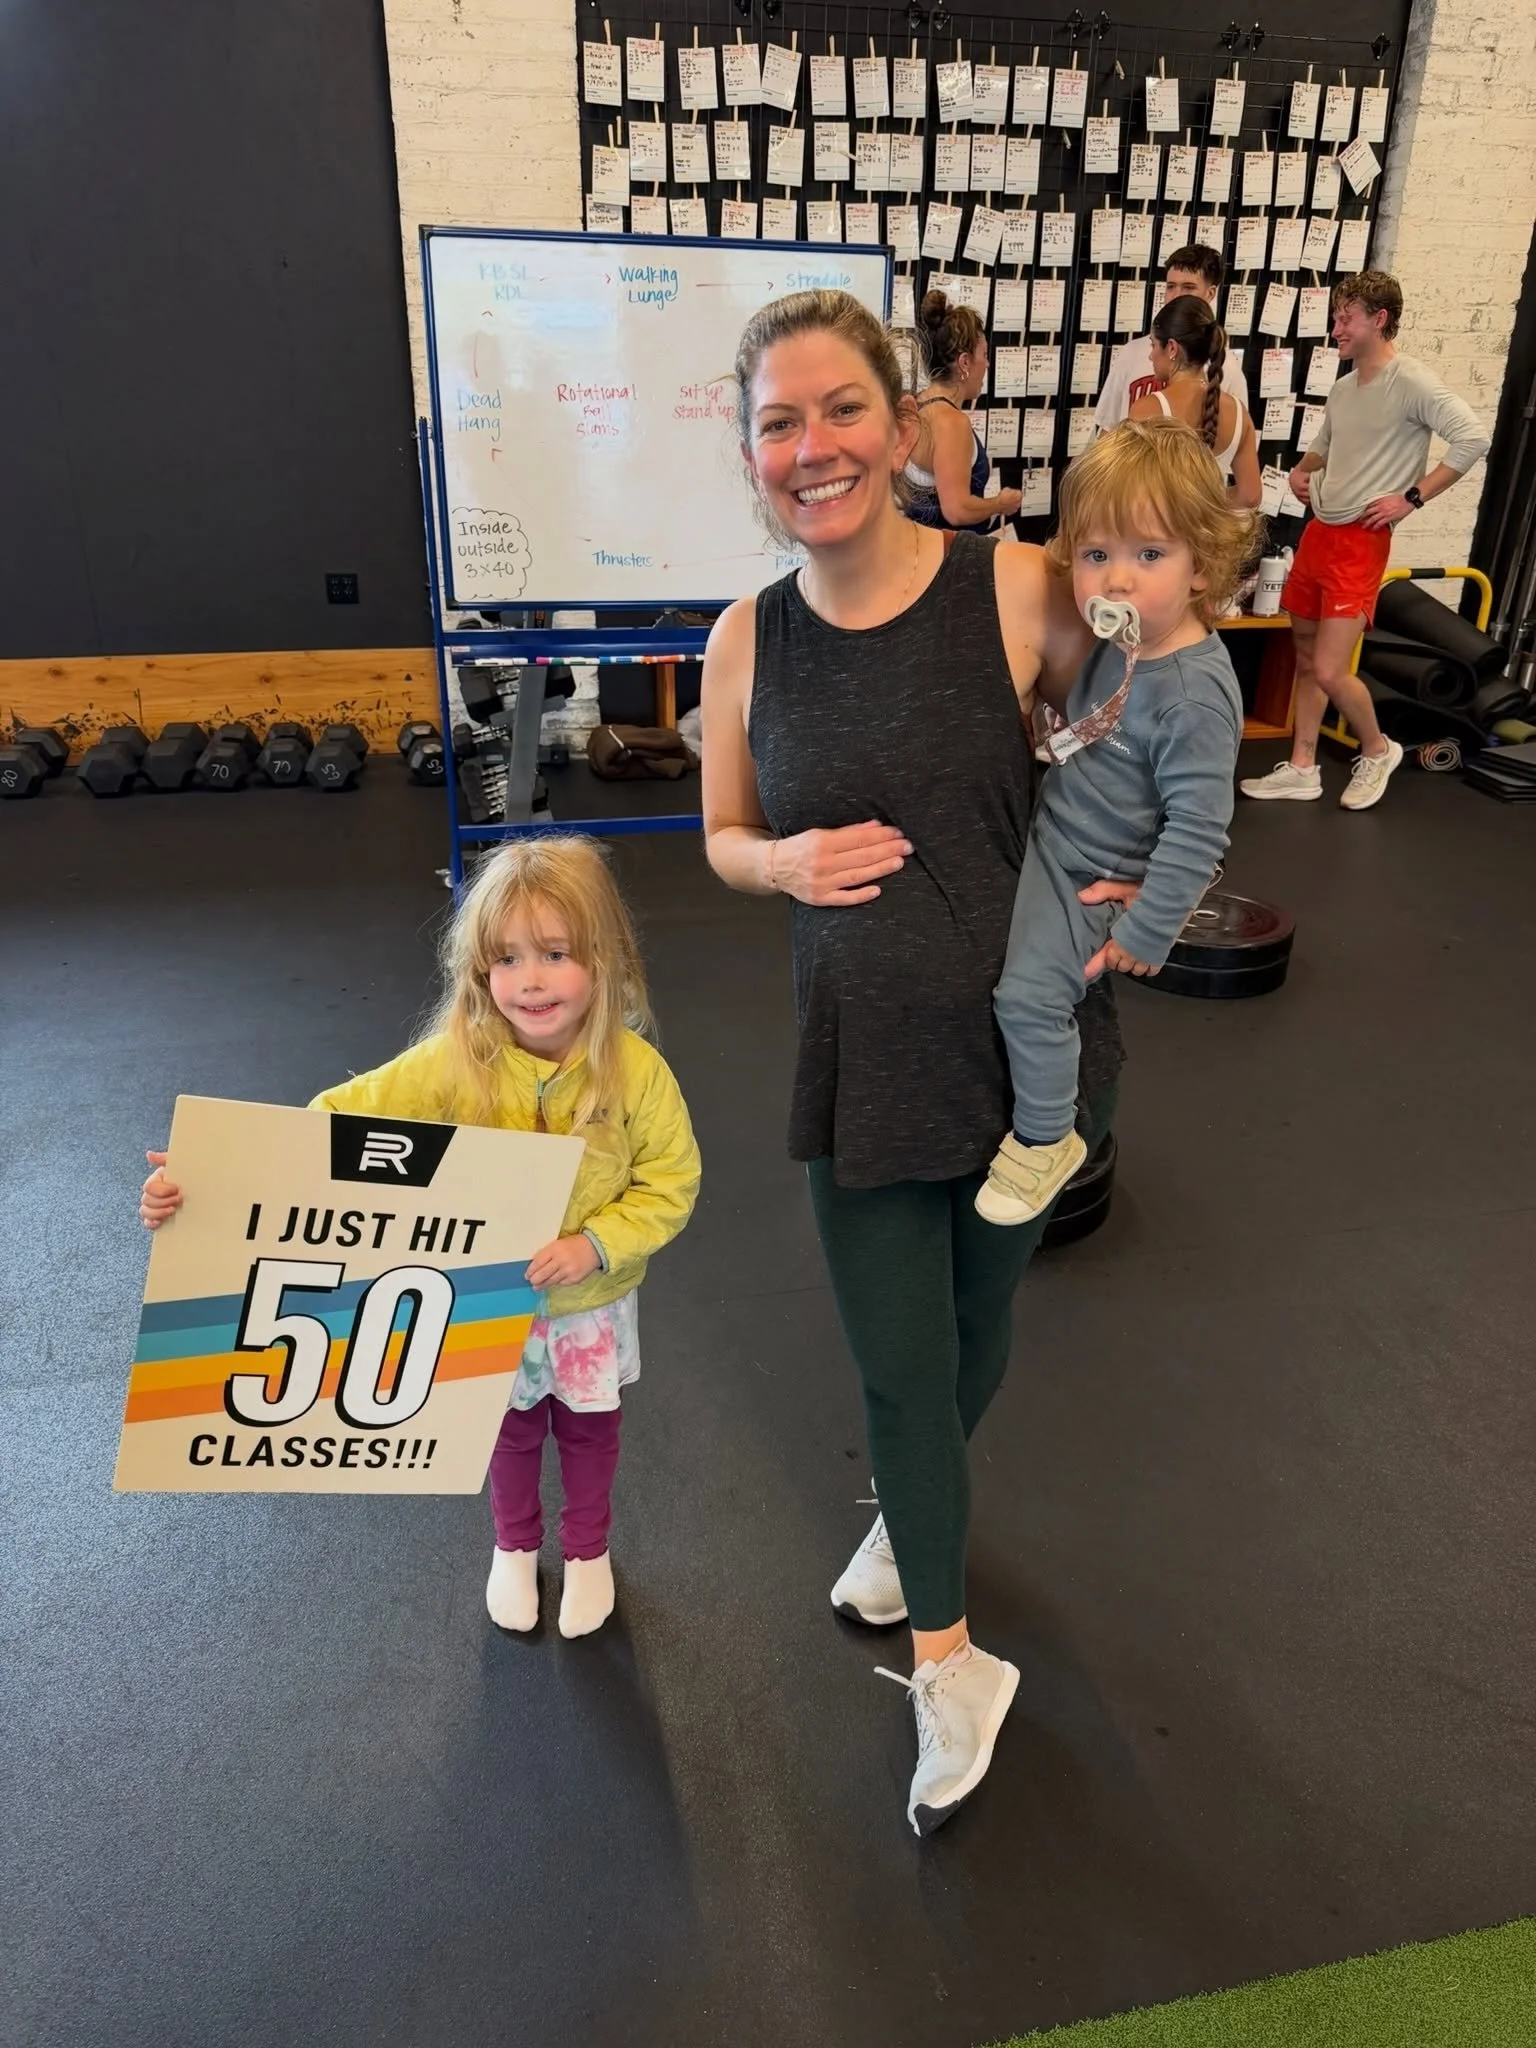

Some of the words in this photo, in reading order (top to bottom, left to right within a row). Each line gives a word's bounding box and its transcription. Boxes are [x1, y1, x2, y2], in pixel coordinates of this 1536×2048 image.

[618, 265, 679, 293] Walking
[628, 288, 677, 311] Lunge
[458, 389, 501, 411] Dead
[556, 382, 638, 403] Rotational
[718, 404, 736, 424] up
[458, 416, 501, 441] Hang
[457, 521, 513, 536] Inside
[592, 550, 653, 568] Thrusters
[1, 769, 18, 788] 80
[211, 763, 230, 779] 70
[245, 1203, 262, 1241] I
[279, 1206, 396, 1250] JUST
[408, 1215, 487, 1255] HIT
[223, 1256, 457, 1431] 50
[187, 1433, 438, 1470] CLASSES!!!
